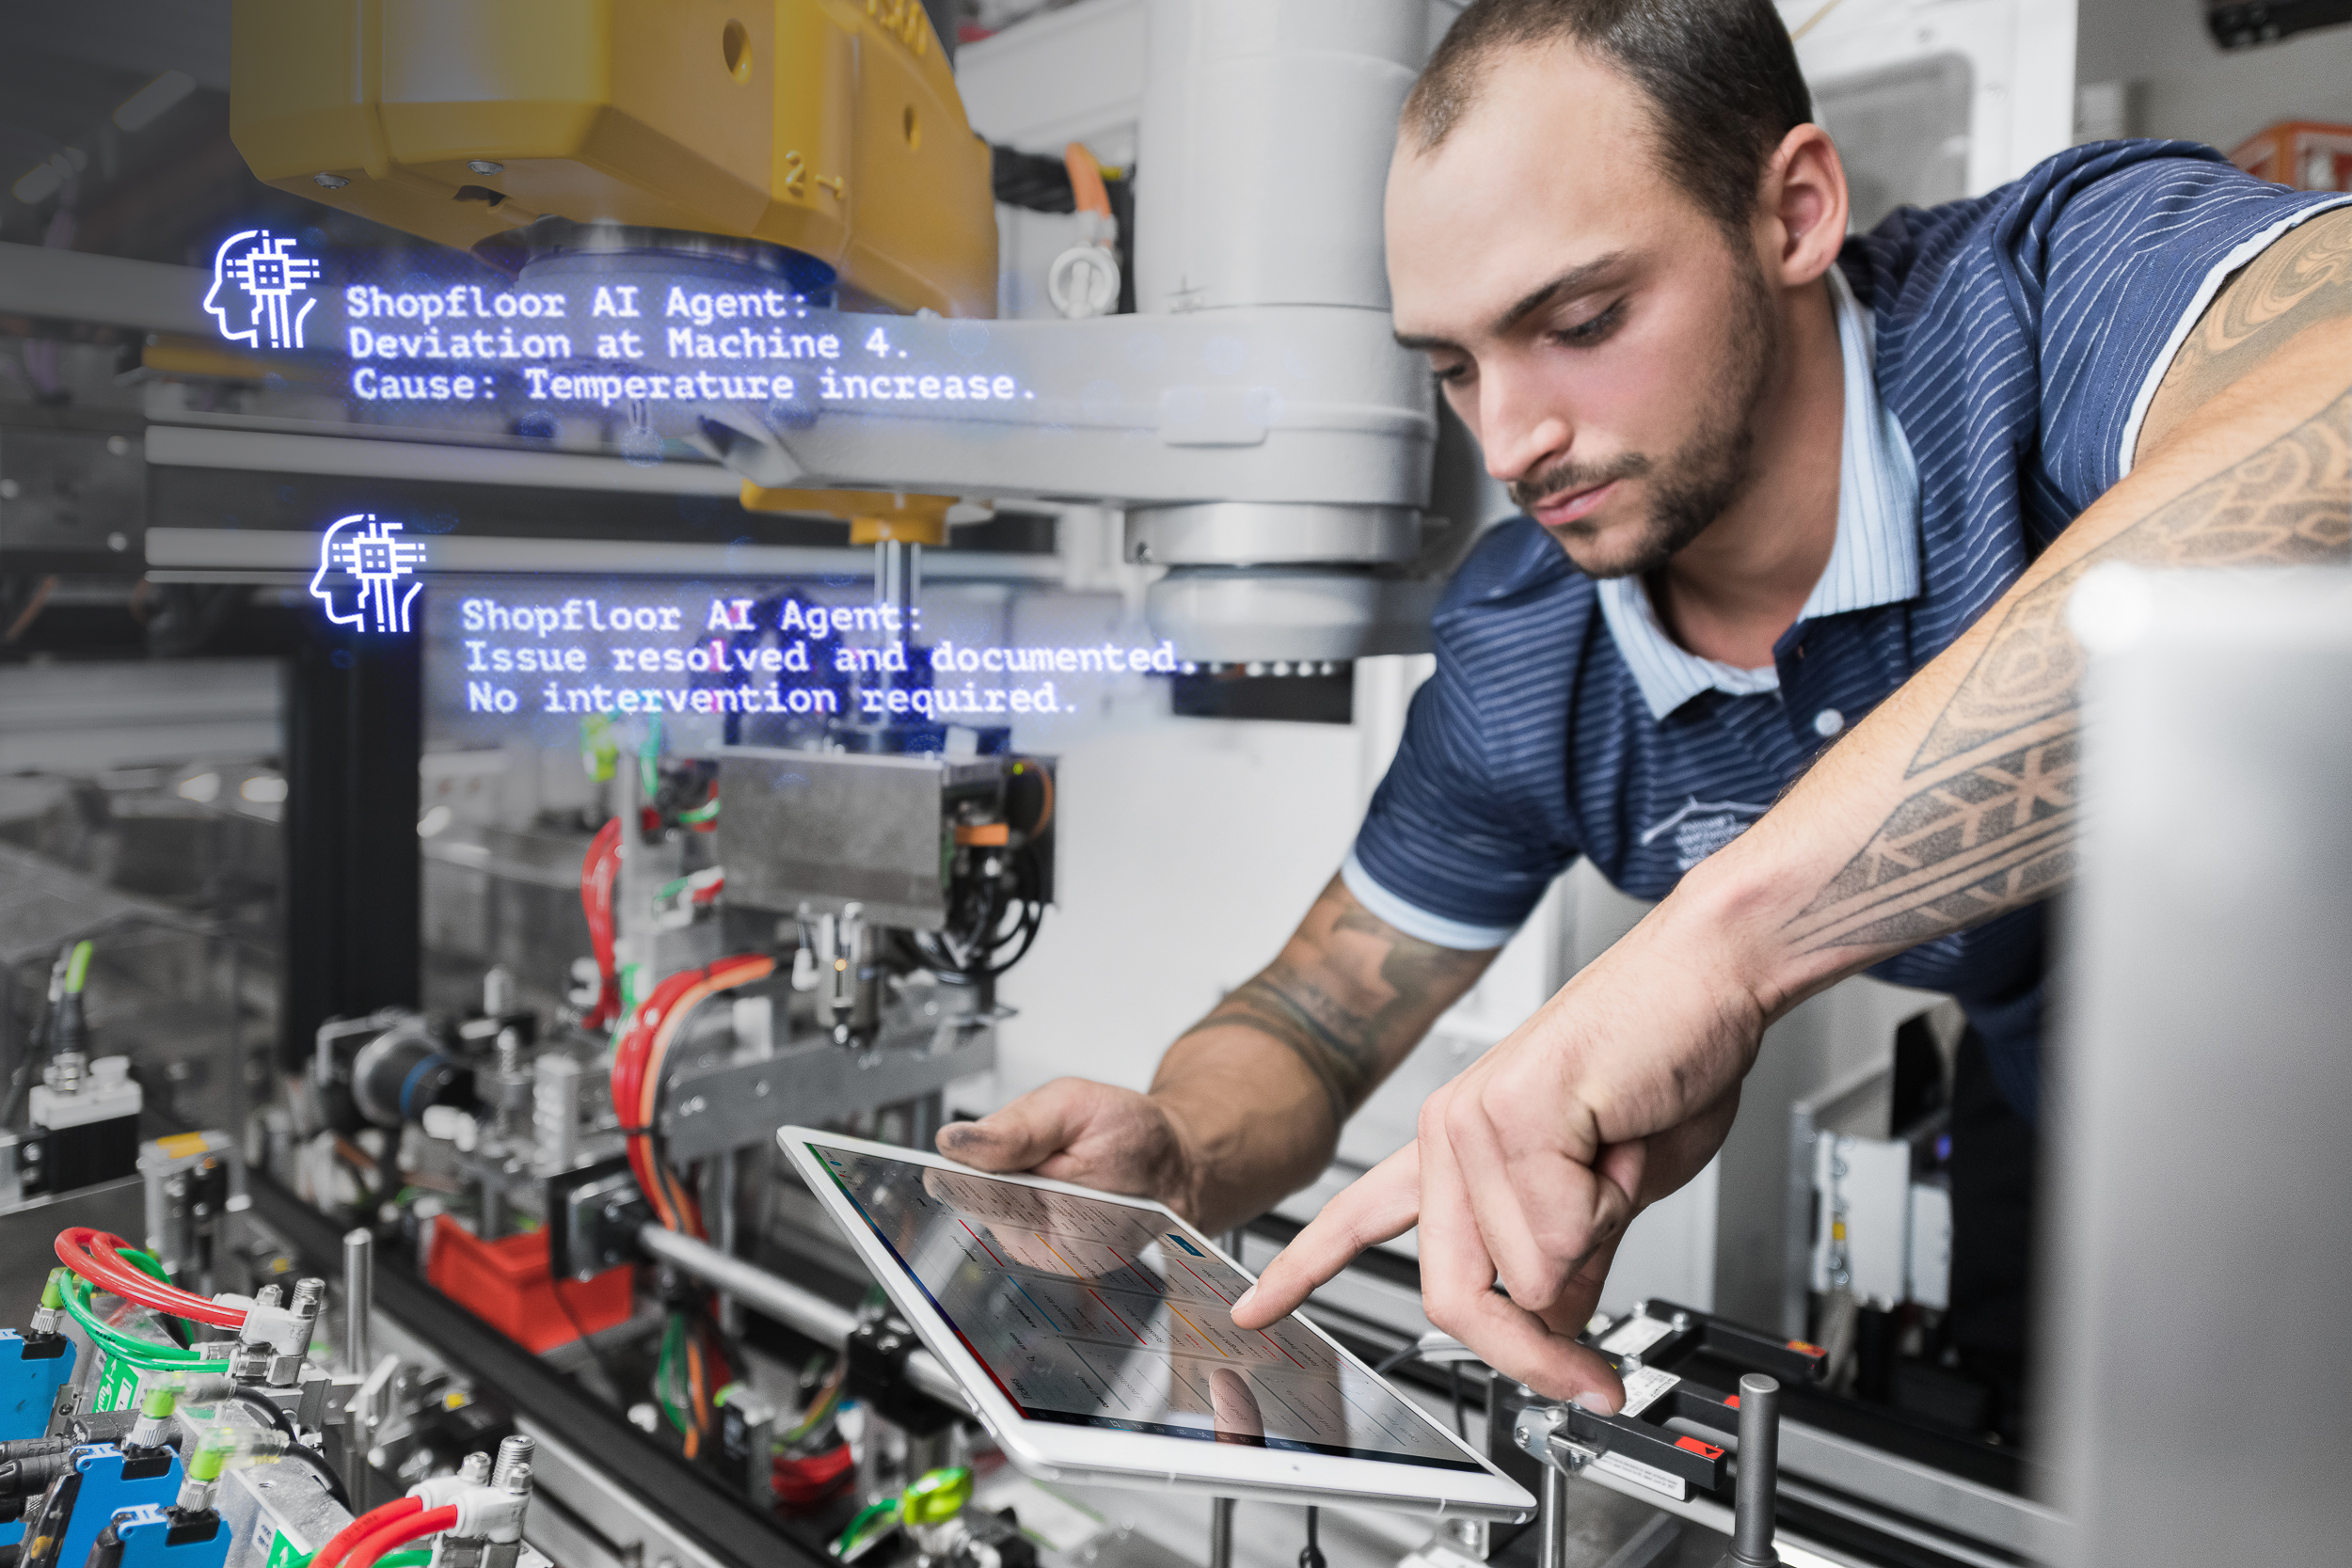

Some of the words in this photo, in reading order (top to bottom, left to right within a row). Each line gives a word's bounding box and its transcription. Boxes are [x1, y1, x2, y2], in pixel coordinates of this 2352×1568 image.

[1082, 1265, 1101, 1279] Weight
[1052, 1304, 1080, 1330] Resistance
[1136, 1317, 1164, 1342] Resistance
[1222, 1338, 1244, 1354] Weight
[1279, 1336, 1297, 1349] Trend
[1010, 1378, 1032, 1399] Tickets
